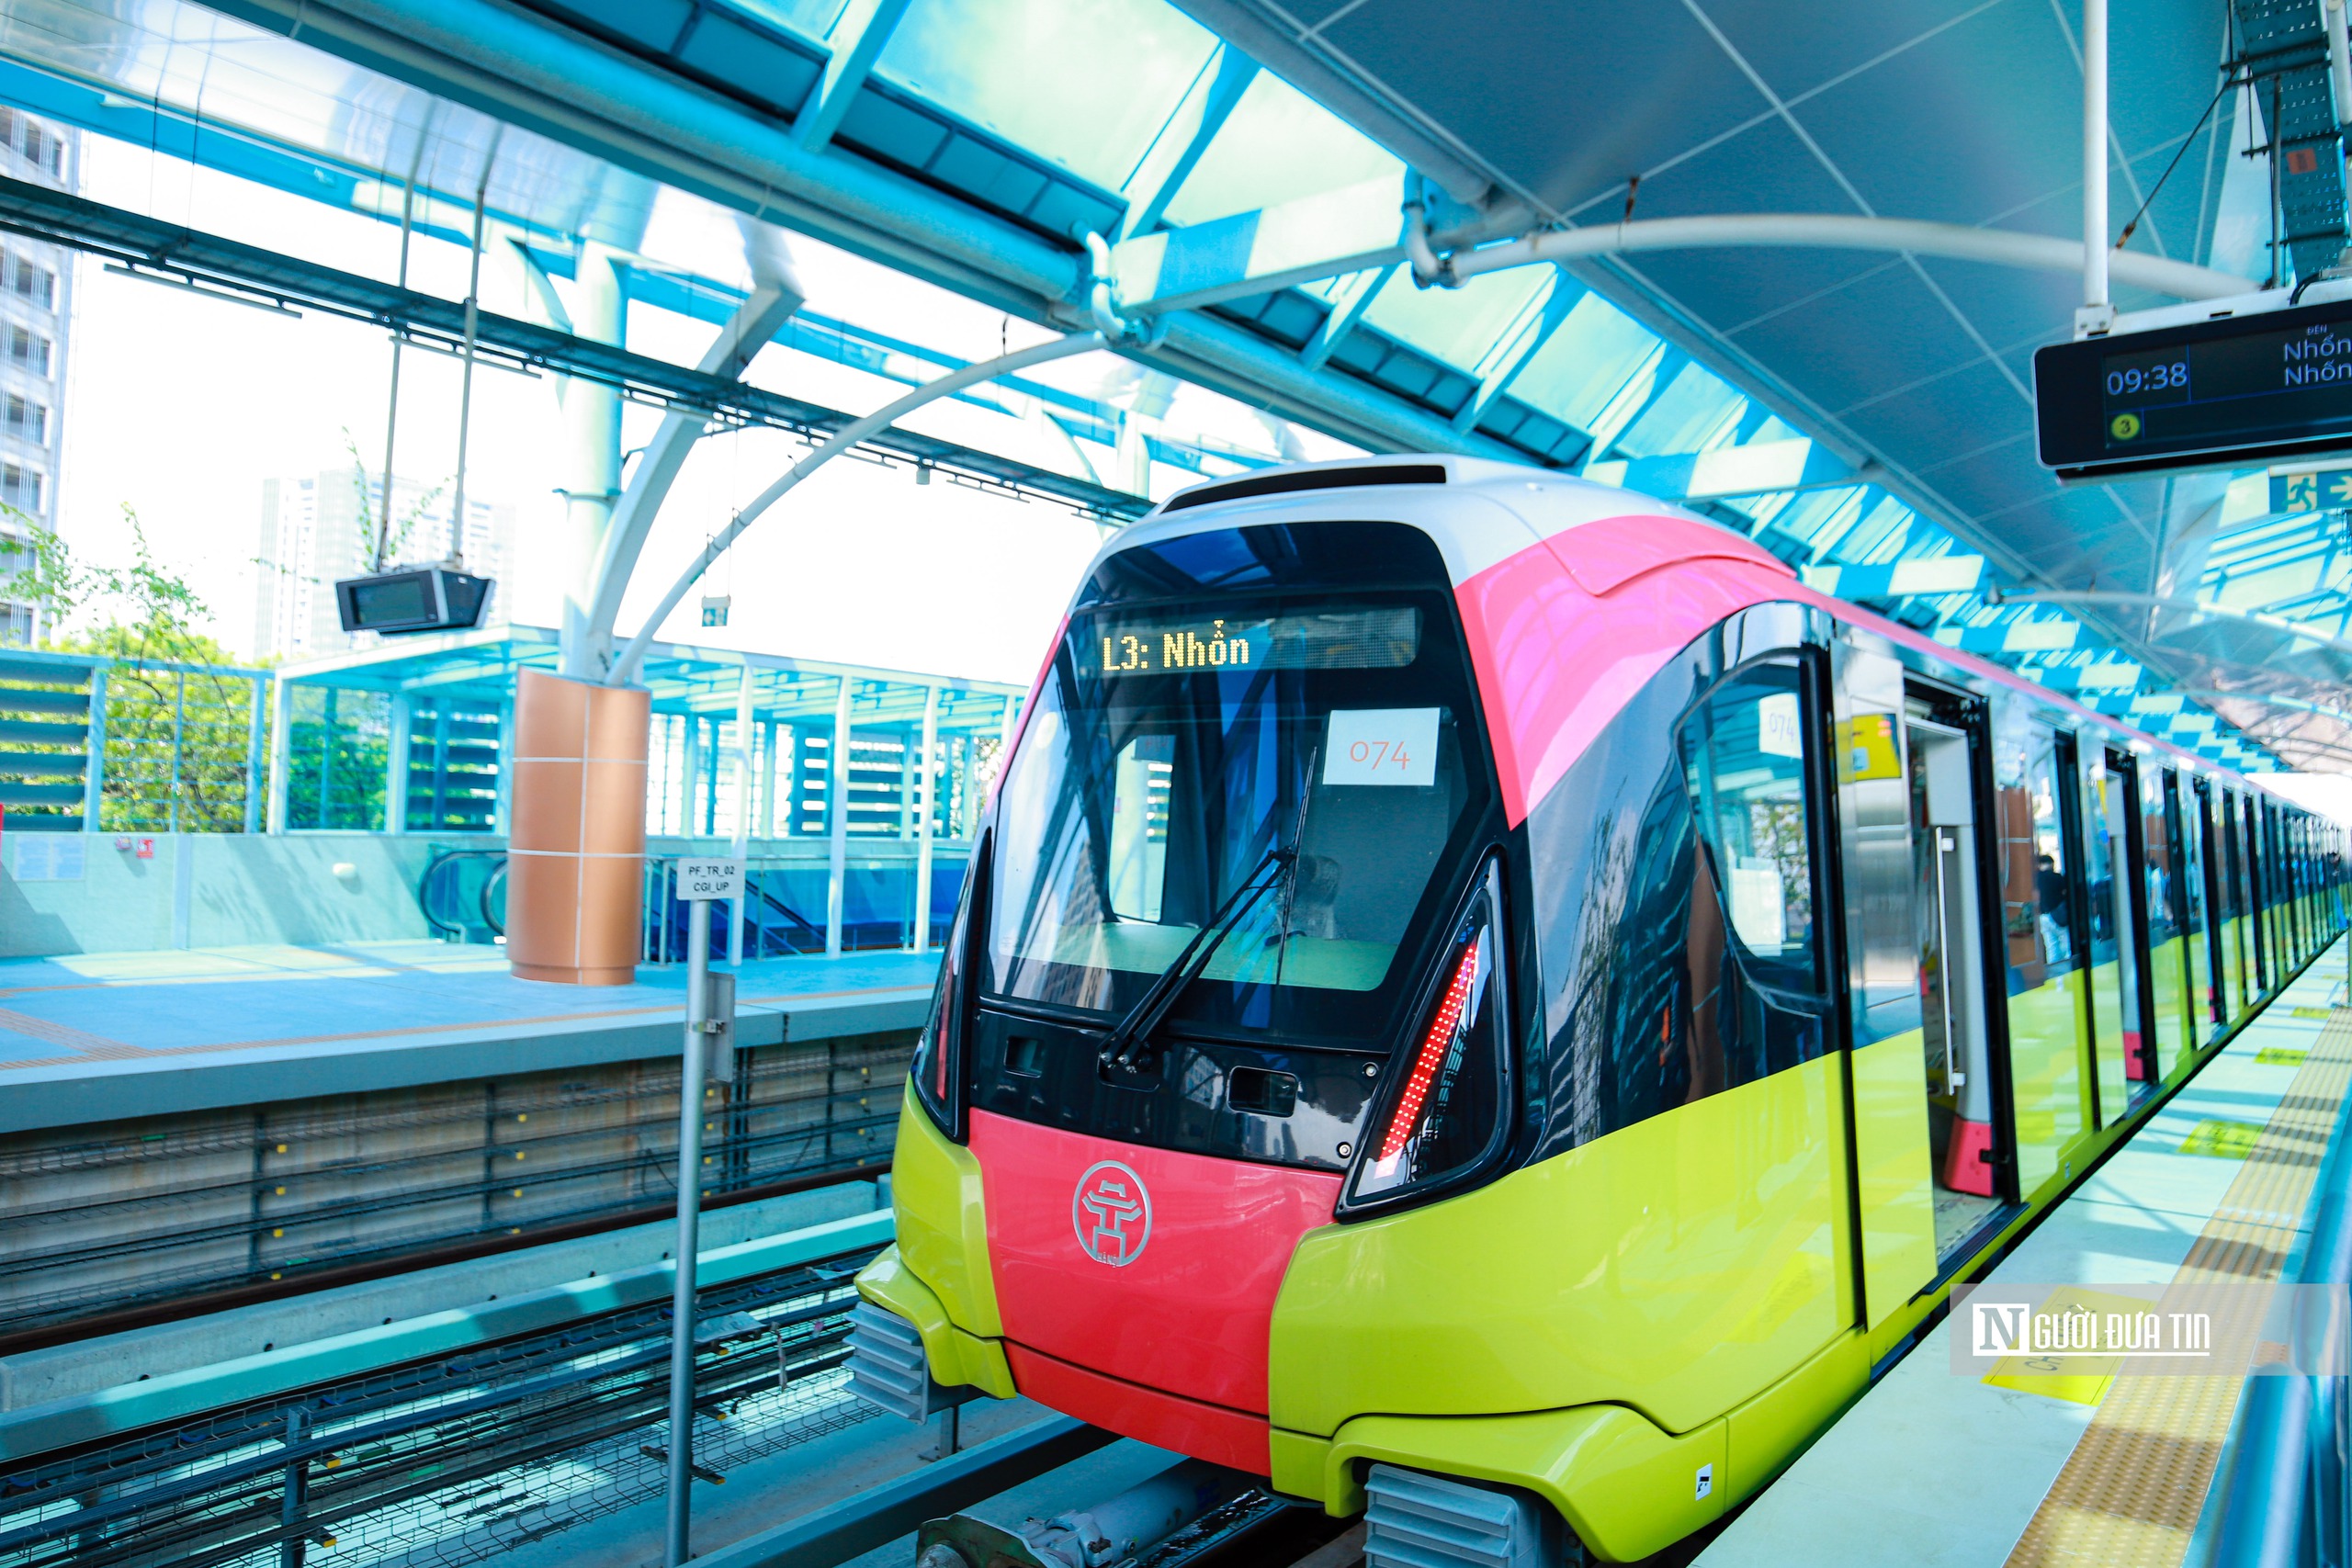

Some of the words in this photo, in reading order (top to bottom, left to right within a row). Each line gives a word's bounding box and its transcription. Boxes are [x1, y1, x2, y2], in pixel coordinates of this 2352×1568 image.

[2107, 362, 2188, 396] 09:38
[2120, 418, 2132, 435] 3
[1103, 635, 1148, 671] L3:
[1769, 712, 1795, 742] 074
[1350, 740, 1411, 771] 074
[688, 866, 735, 877] PF_TR_02
[694, 882, 729, 893] CGI_UP
